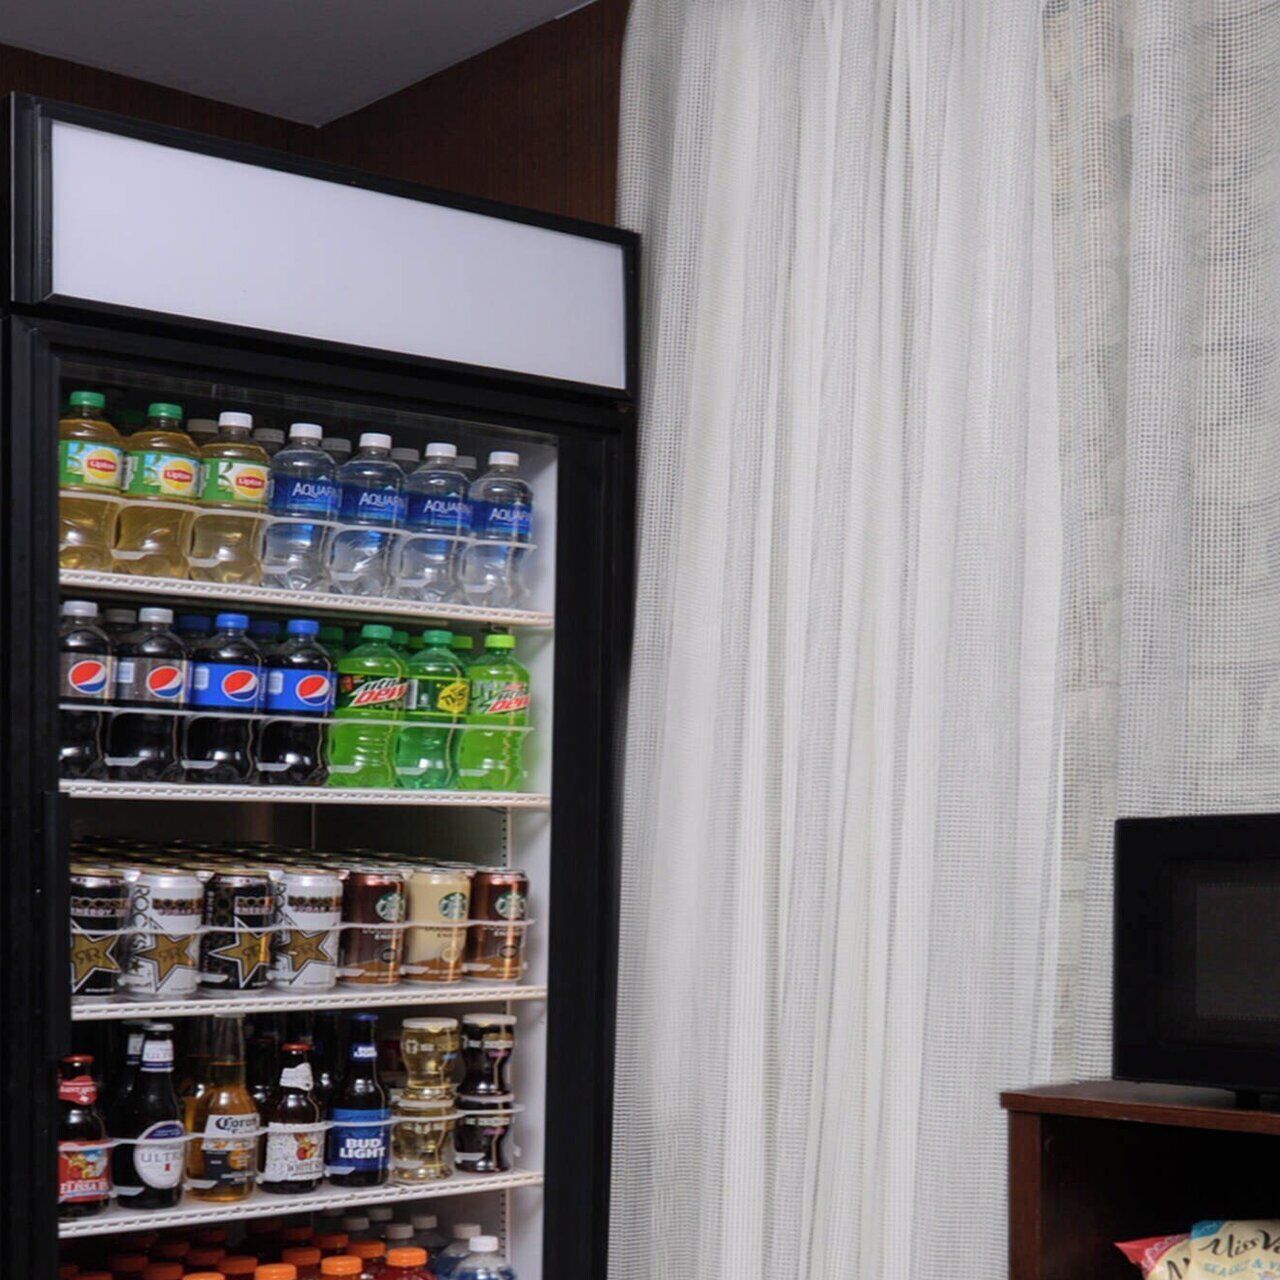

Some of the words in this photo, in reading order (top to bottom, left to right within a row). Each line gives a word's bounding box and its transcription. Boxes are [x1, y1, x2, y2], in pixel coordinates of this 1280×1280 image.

[90, 460, 117, 470] Lipton
[166, 470, 193, 482] Lipton
[239, 477, 265, 489] Lipton
[292, 482, 342, 498] AQUAF
[358, 492, 408, 507] AQUAF
[423, 499, 472, 514] AQUAF
[489, 507, 532, 522] AQUAF
[346, 1138, 381, 1149] BUD
[141, 1151, 183, 1163] ULTR
[339, 1147, 386, 1159] LIGHT
